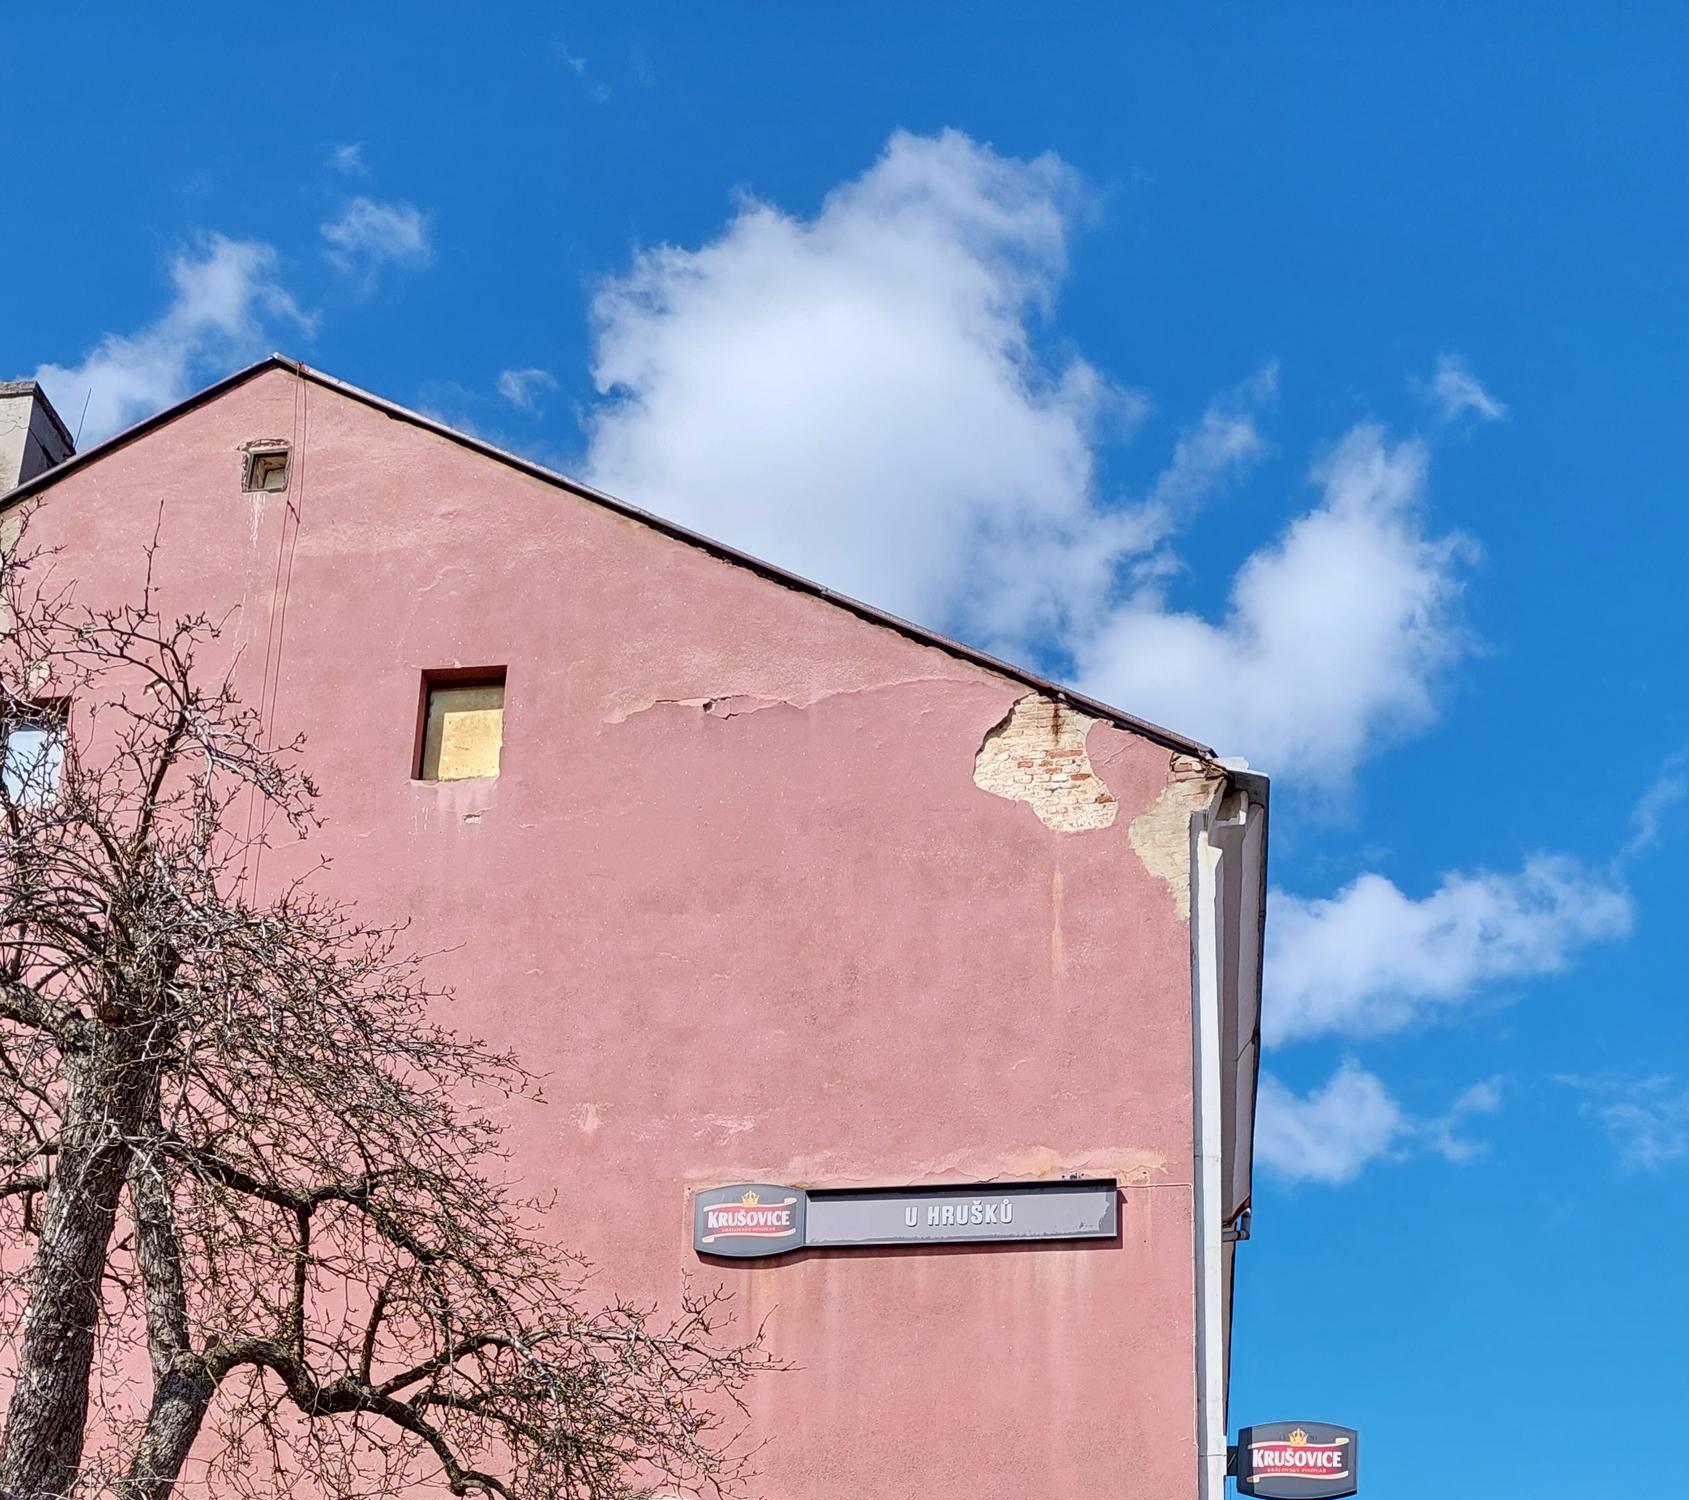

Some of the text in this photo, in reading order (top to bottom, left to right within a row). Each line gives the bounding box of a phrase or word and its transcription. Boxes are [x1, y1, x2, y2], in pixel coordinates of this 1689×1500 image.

[707, 1208, 790, 1228] KRUŠOVICE
[905, 1199, 1013, 1227] U HRUŠKŮ
[1252, 1448, 1342, 1467] KRUŠOVICE
